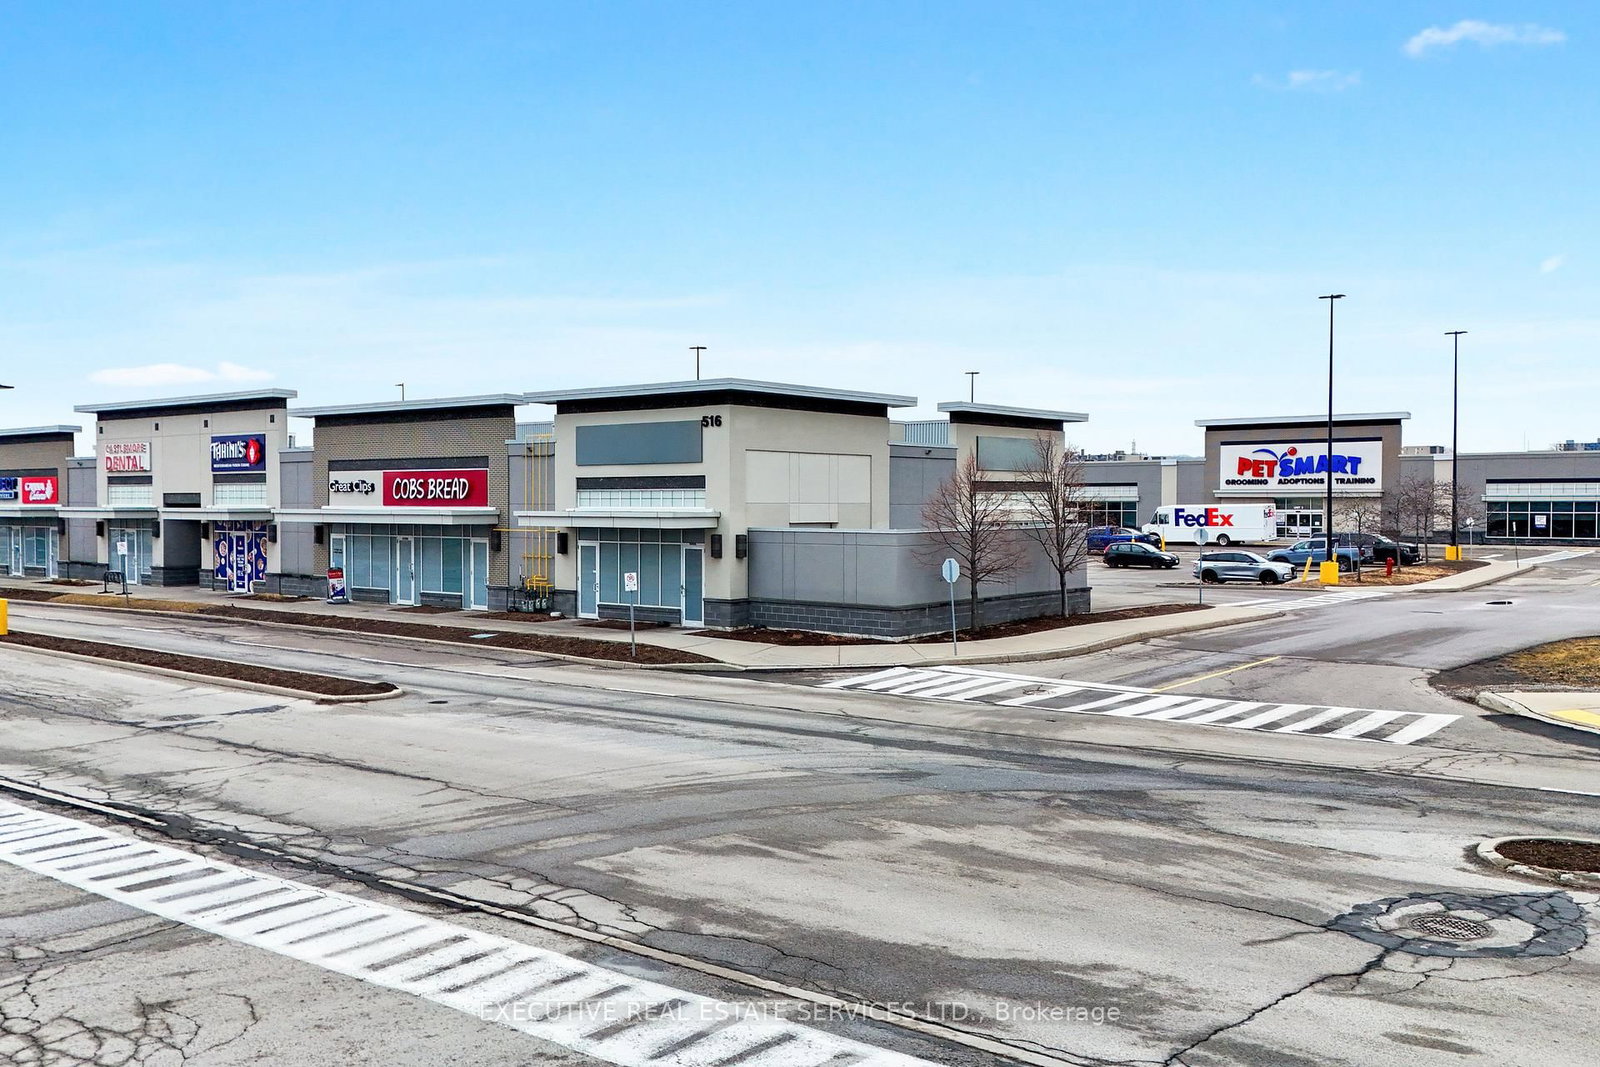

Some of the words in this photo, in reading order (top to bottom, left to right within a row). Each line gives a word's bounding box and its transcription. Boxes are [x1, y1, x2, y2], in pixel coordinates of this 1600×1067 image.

[701, 415, 722, 428] 516
[106, 455, 144, 470] DENTAL
[329, 480, 351, 493] Great
[353, 480, 373, 495] Clips
[392, 477, 425, 500] COBS
[427, 477, 469, 500] BREAD
[1335, 477, 1376, 485] TRAINING
[1174, 508, 1234, 527] FedEx
